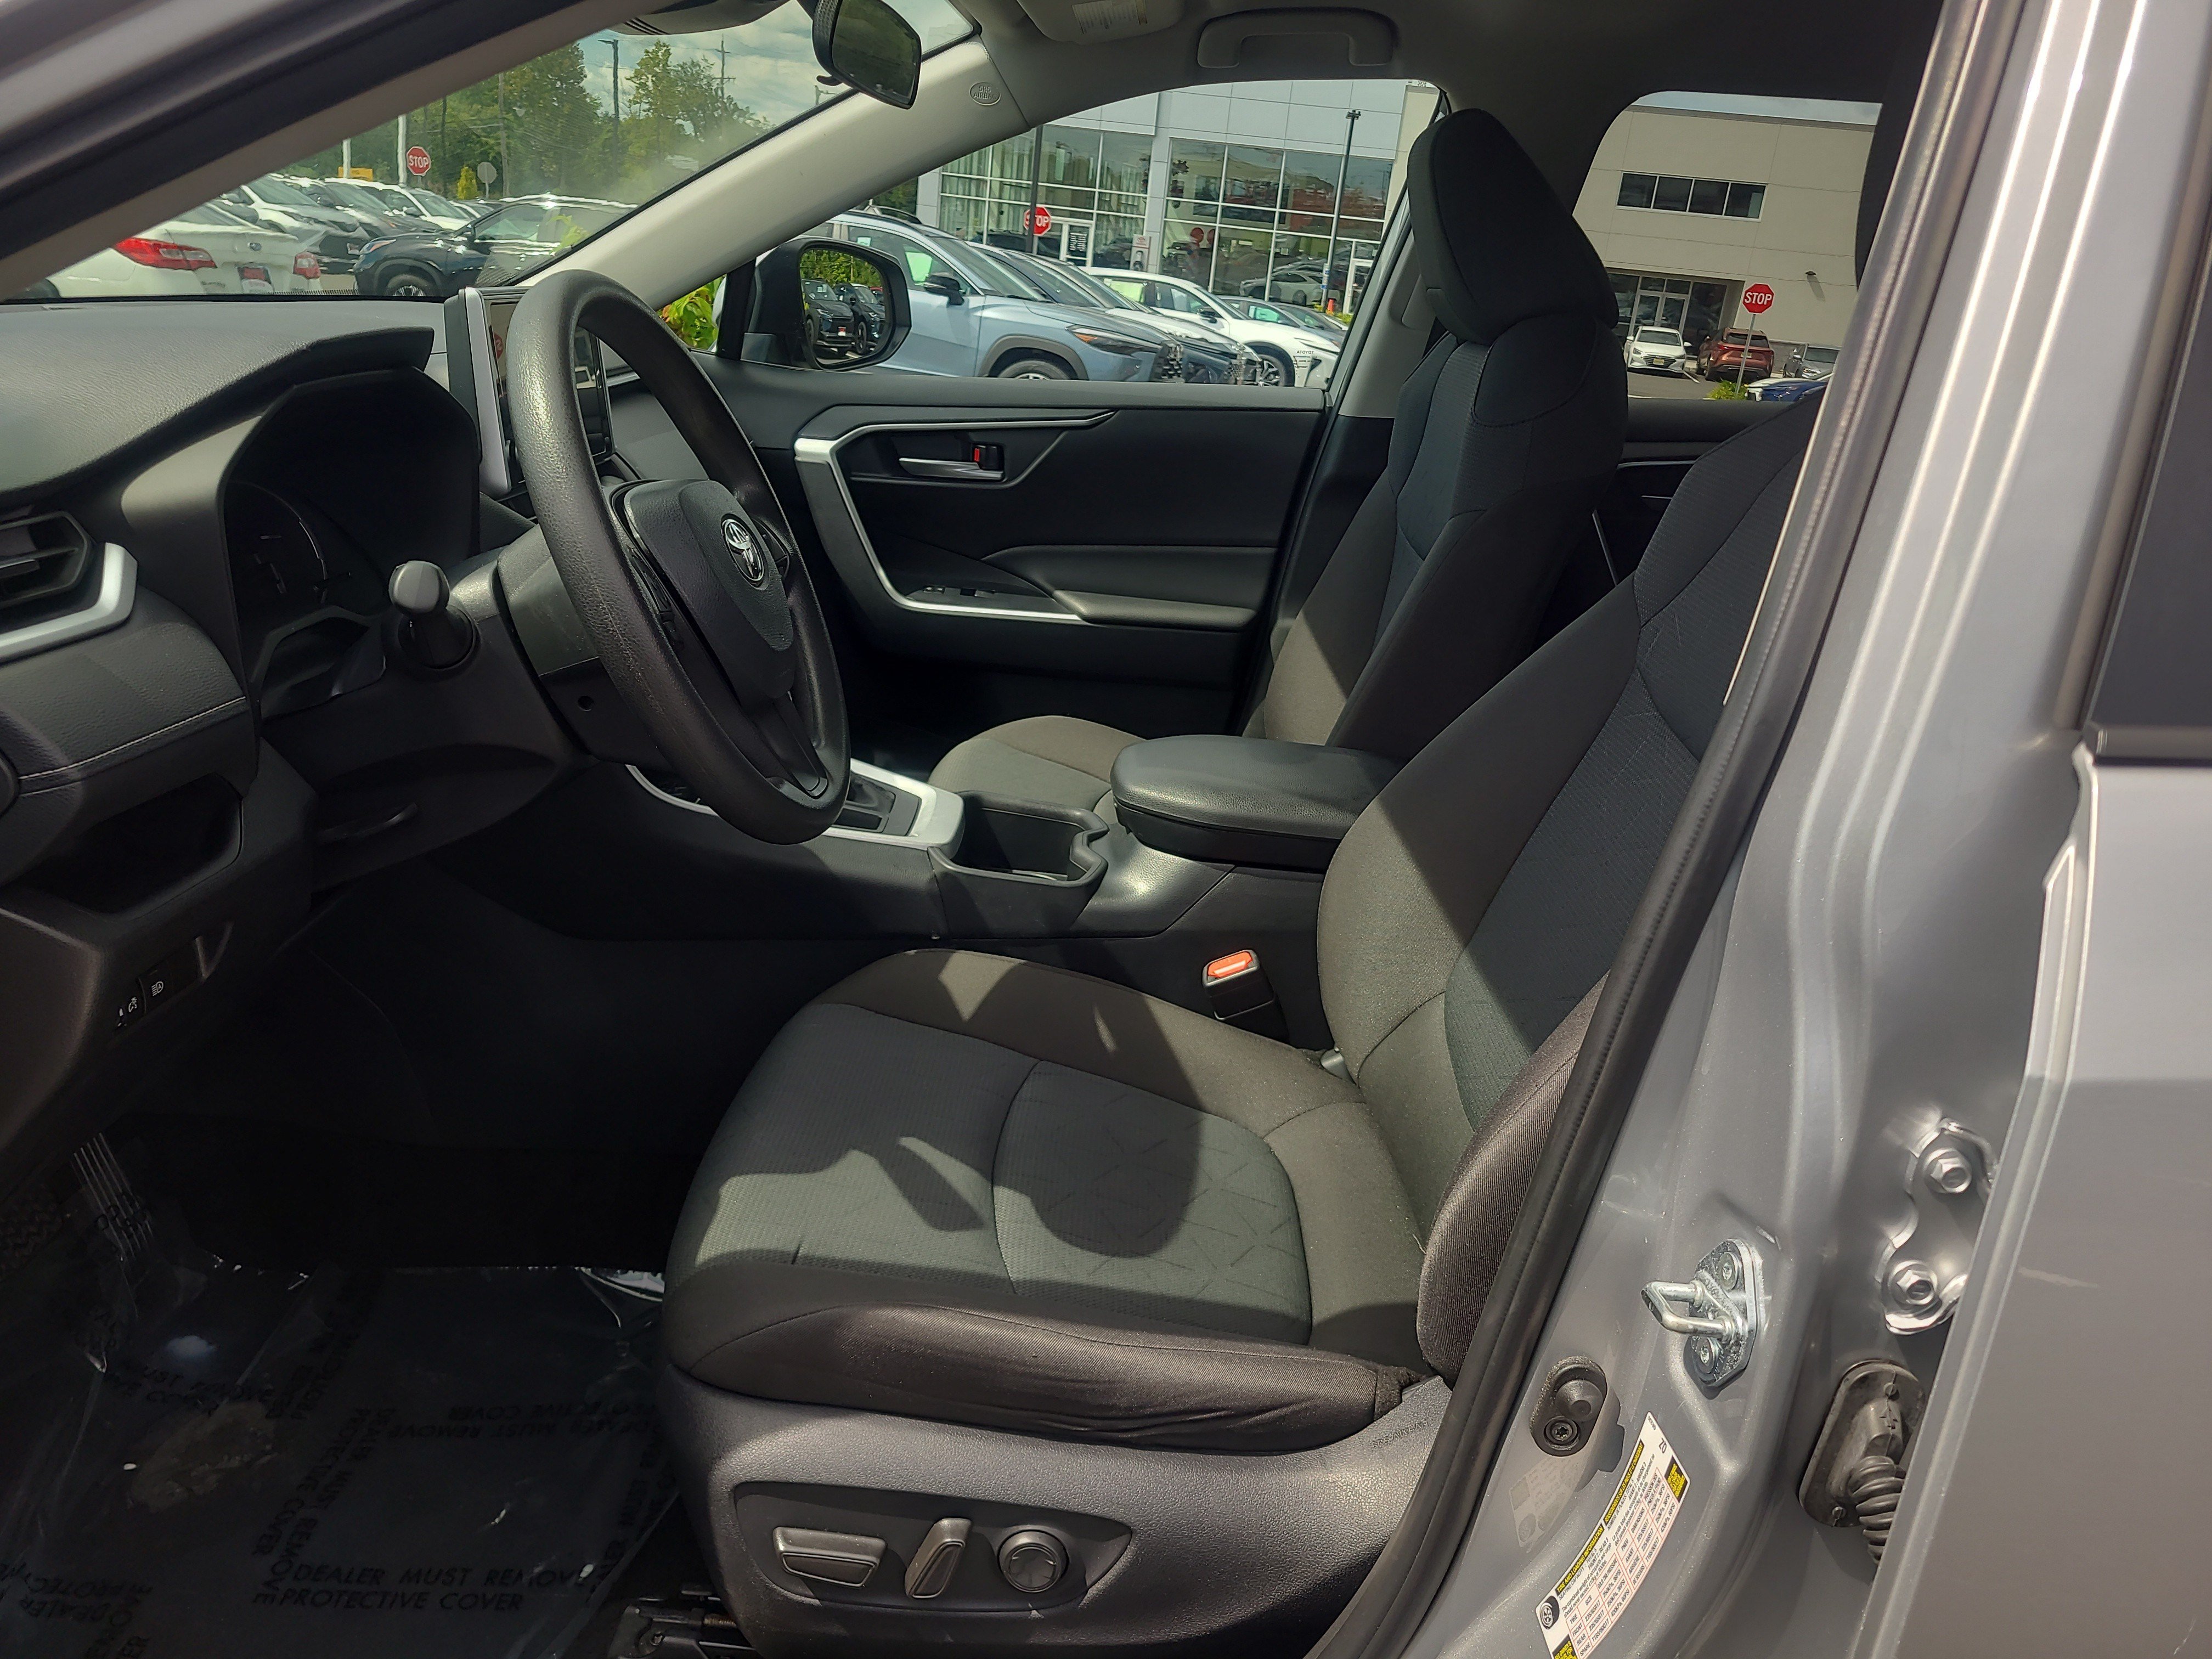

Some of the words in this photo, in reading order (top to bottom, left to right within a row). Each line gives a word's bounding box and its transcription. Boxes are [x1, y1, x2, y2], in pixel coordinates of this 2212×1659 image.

[409, 155, 429, 168] STOP
[1745, 292, 1772, 305] STOP
[292, 1563, 386, 1586] DEALER
[398, 1566, 473, 1587] MUST
[279, 1588, 431, 1610] PROTECTIVE
[439, 1591, 525, 1612] COVER
[1572, 1621, 1583, 1637] FRONT
[1576, 1632, 1586, 1646] REAR
[1579, 1641, 1590, 1657] SPARE
